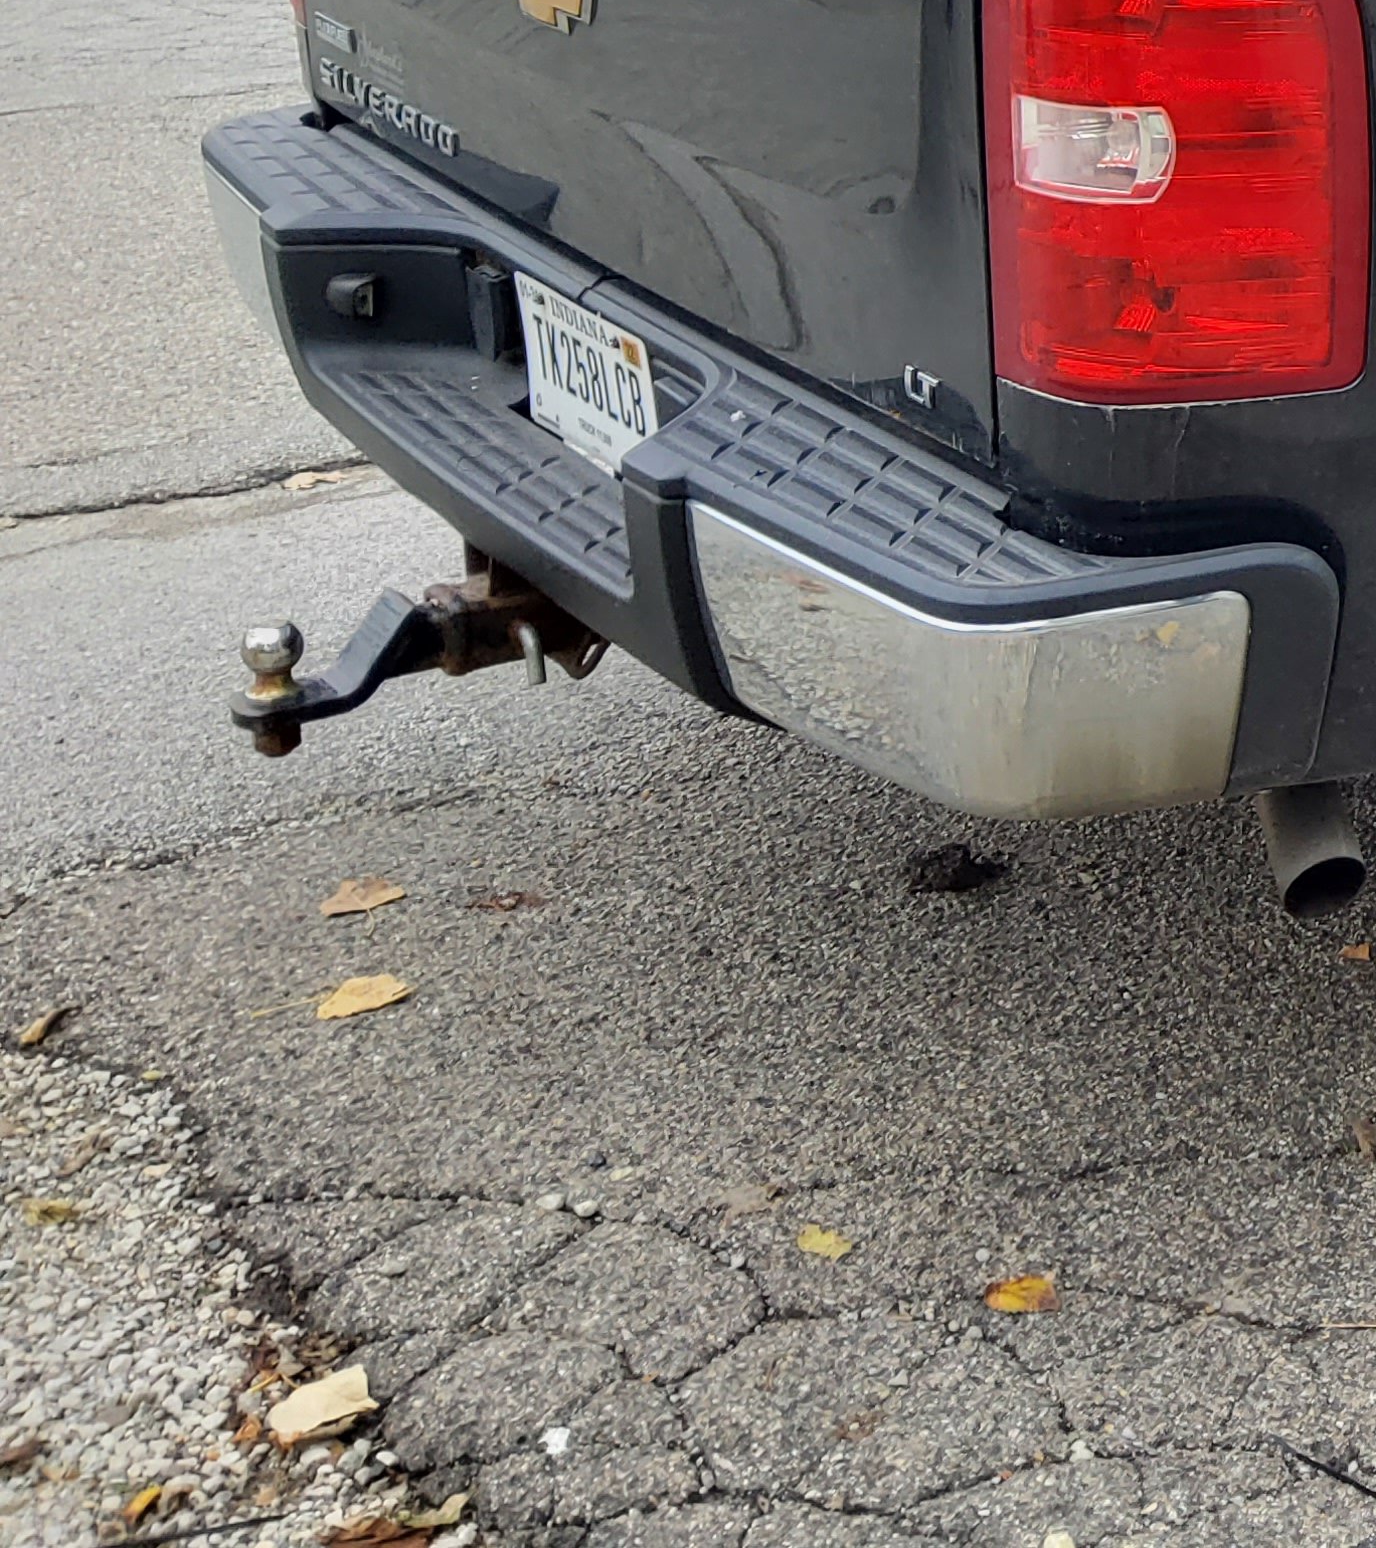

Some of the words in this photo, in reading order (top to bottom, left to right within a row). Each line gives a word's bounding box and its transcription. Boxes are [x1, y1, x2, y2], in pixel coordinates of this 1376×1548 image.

[319, 57, 461, 157] SILVERADO
[548, 294, 610, 348] INDIANA
[532, 313, 646, 437] TK258LCB
[904, 365, 940, 409] LT
